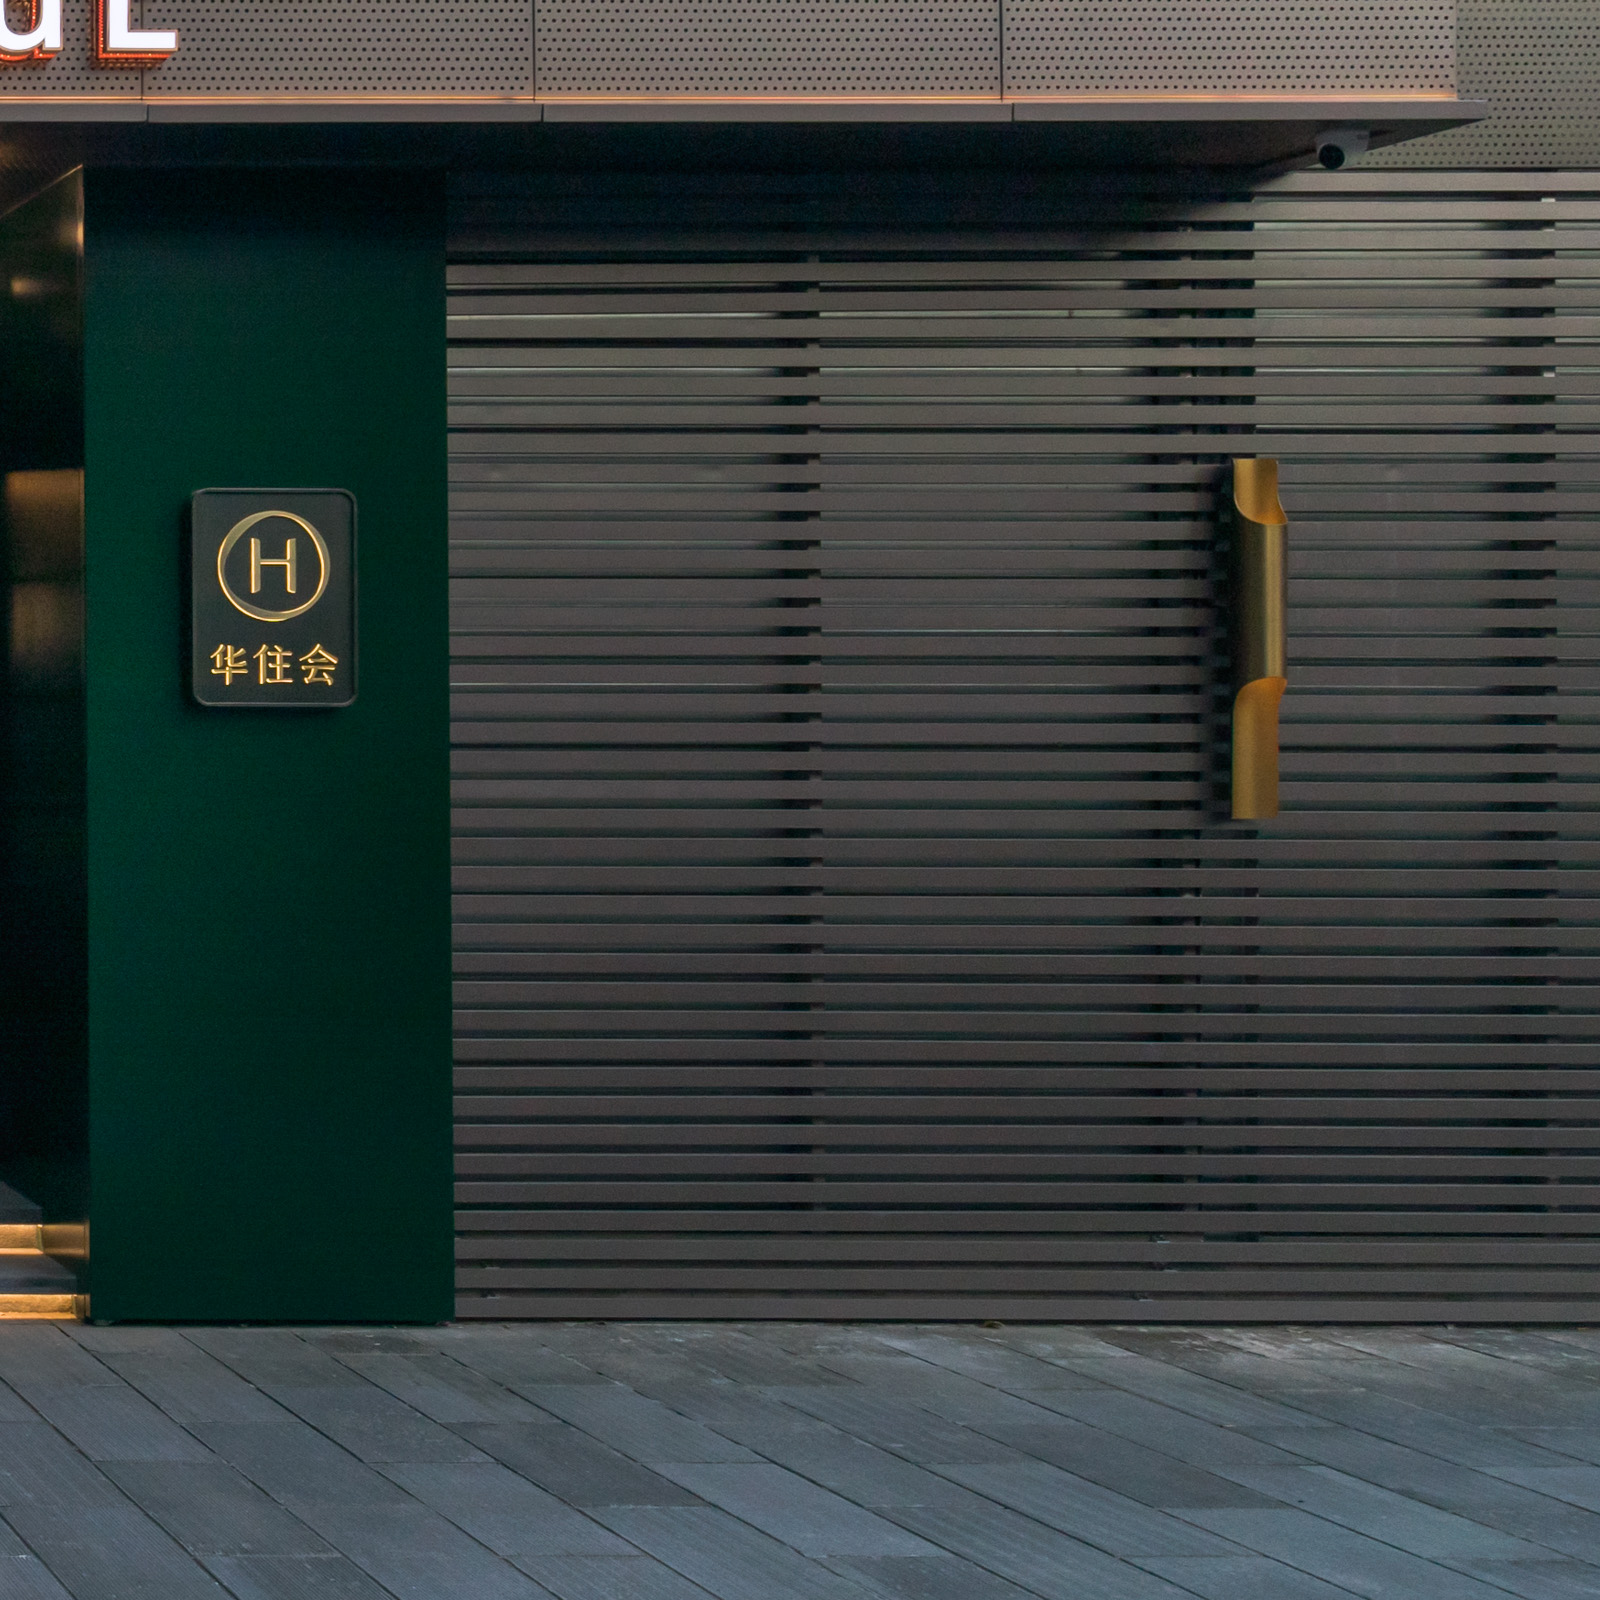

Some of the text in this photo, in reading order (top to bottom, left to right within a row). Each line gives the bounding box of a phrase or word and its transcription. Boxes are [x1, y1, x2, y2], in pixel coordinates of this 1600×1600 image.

[249, 537, 297, 594] H
[210, 643, 339, 686] 华住会
